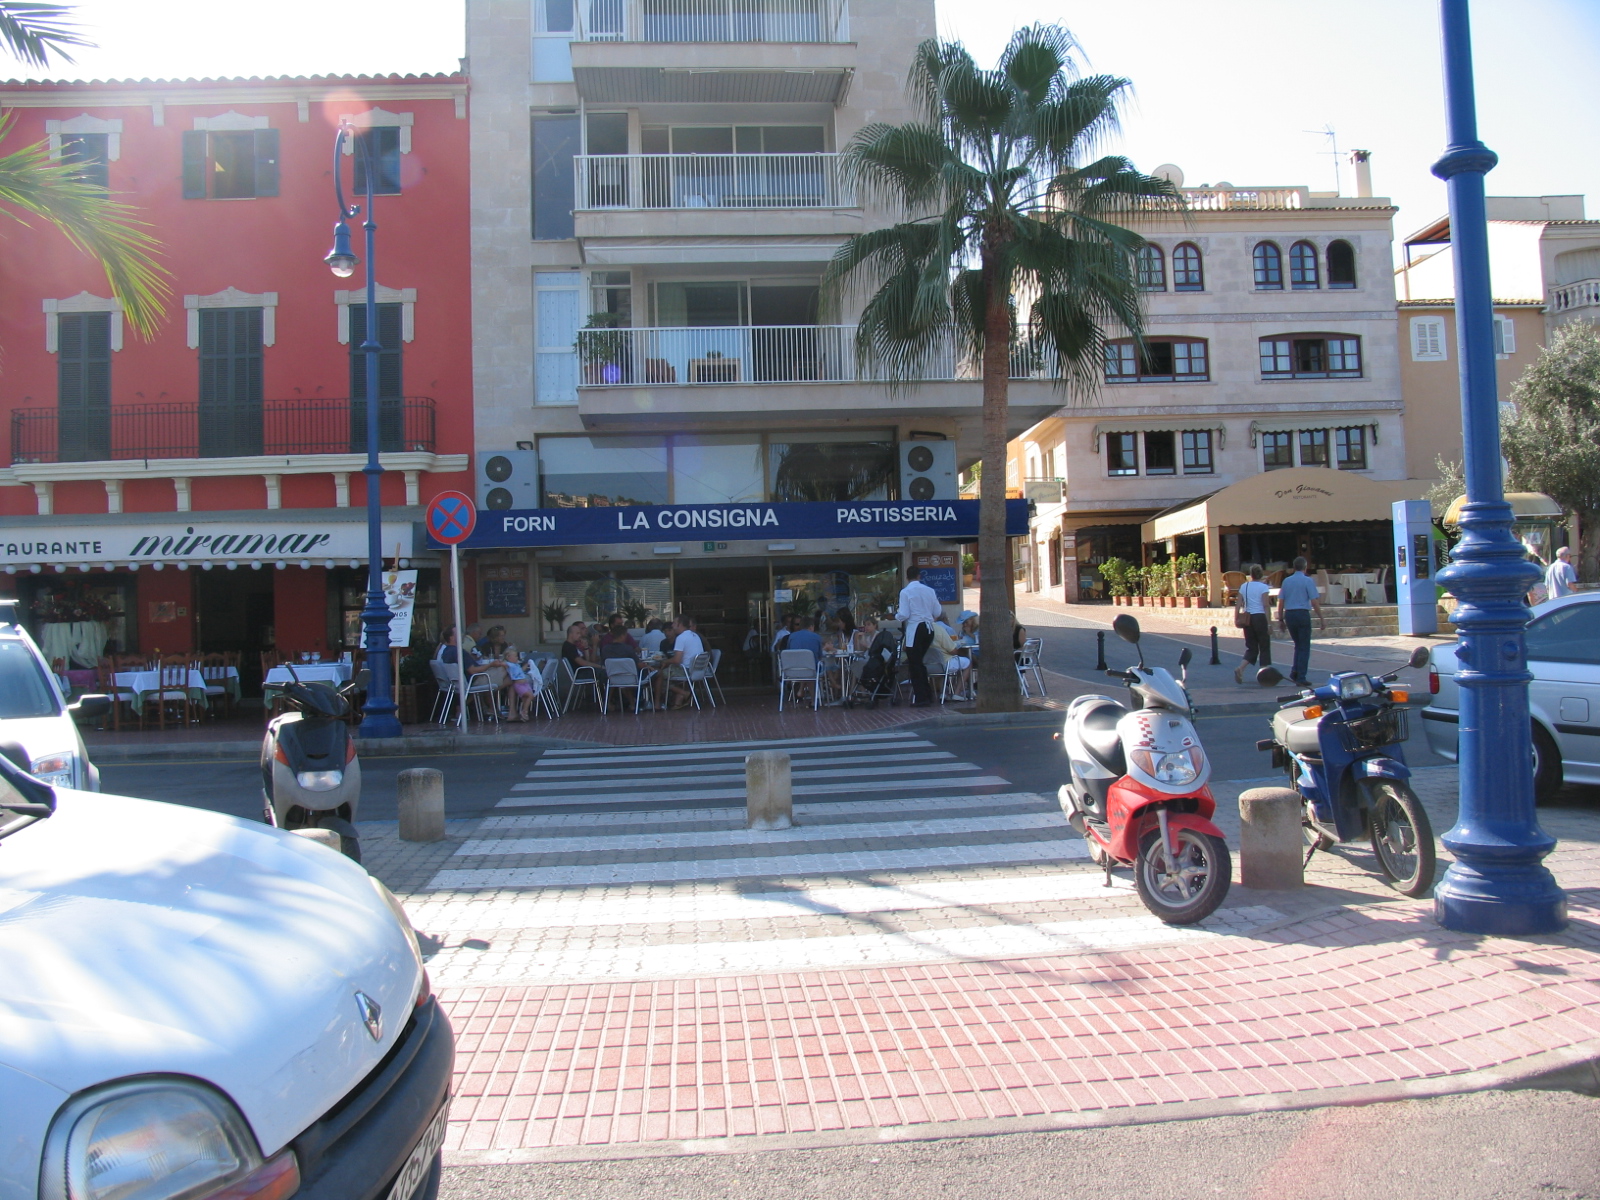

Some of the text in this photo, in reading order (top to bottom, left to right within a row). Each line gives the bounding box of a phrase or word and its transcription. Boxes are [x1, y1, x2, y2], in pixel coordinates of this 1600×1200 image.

[1275, 485, 1334, 498] Don Giovanni
[618, 508, 779, 530] LA CONSIGNA
[837, 506, 957, 523] PASTISSERIA
[503, 516, 556, 532] FORN
[129, 526, 330, 556] miramar
